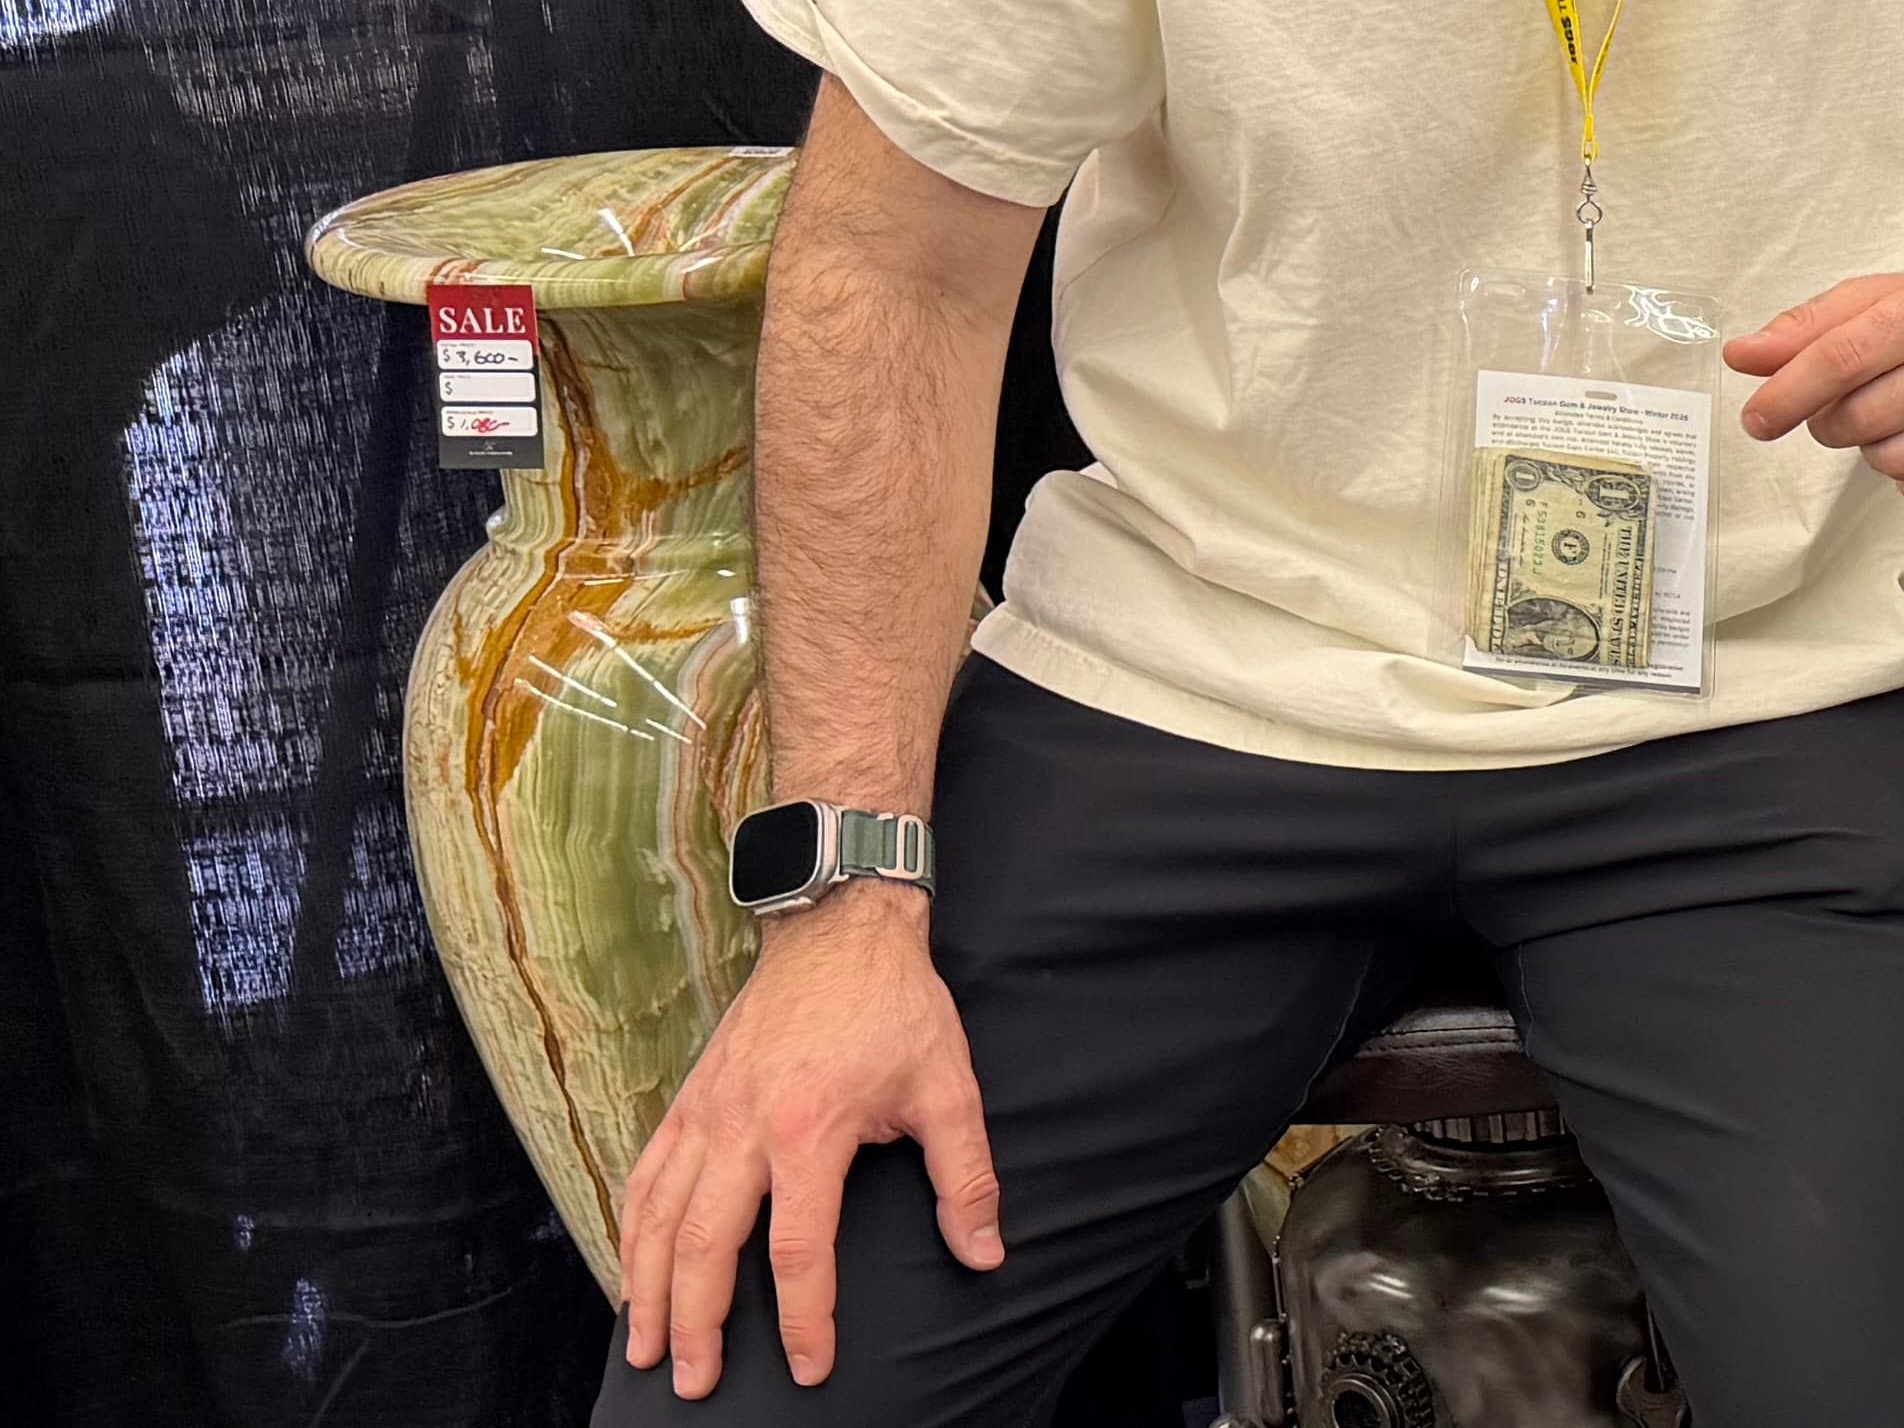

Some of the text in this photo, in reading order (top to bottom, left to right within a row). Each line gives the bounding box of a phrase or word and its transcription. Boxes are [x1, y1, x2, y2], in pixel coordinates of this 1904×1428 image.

[439, 307, 526, 334] SALE
[443, 349, 450, 362] $
[445, 381, 453, 395] $
[447, 416, 455, 429] $
[1563, 541, 1578, 554] F
[1608, 526, 1632, 666] THE UNITED STATES
